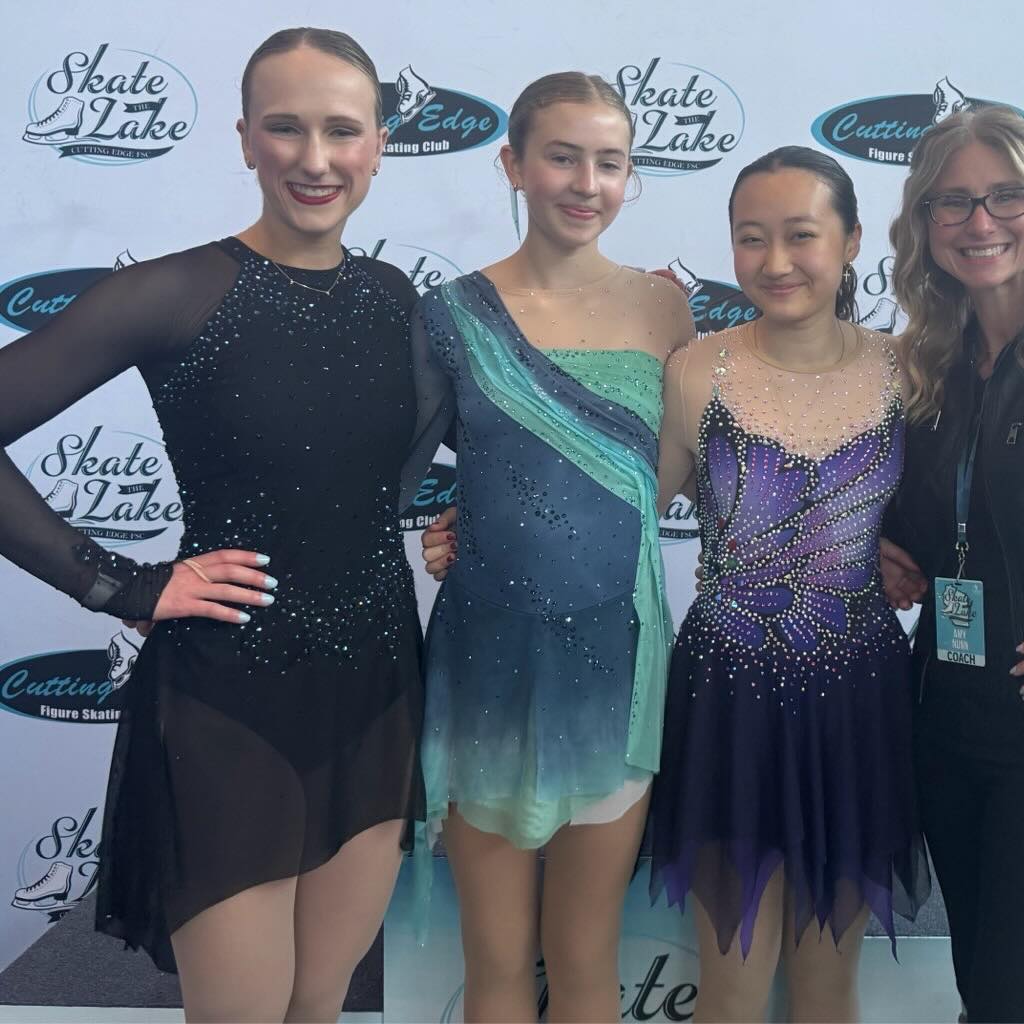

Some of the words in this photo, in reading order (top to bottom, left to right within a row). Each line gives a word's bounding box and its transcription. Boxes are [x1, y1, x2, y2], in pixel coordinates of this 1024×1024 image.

[47, 43, 168, 94] Skate
[86, 97, 188, 140] Lake
[418, 104, 493, 138] Edge
[638, 110, 739, 153] Lake
[832, 113, 930, 141] Cuttin
[422, 140, 450, 151] Club
[868, 148, 906, 162] Figure
[41, 425, 162, 476] Skate
[78, 478, 182, 522] Lake
[947, 651, 976, 665] COACH
[2, 669, 113, 705] Cutting
[40, 704, 79, 719] Figure
